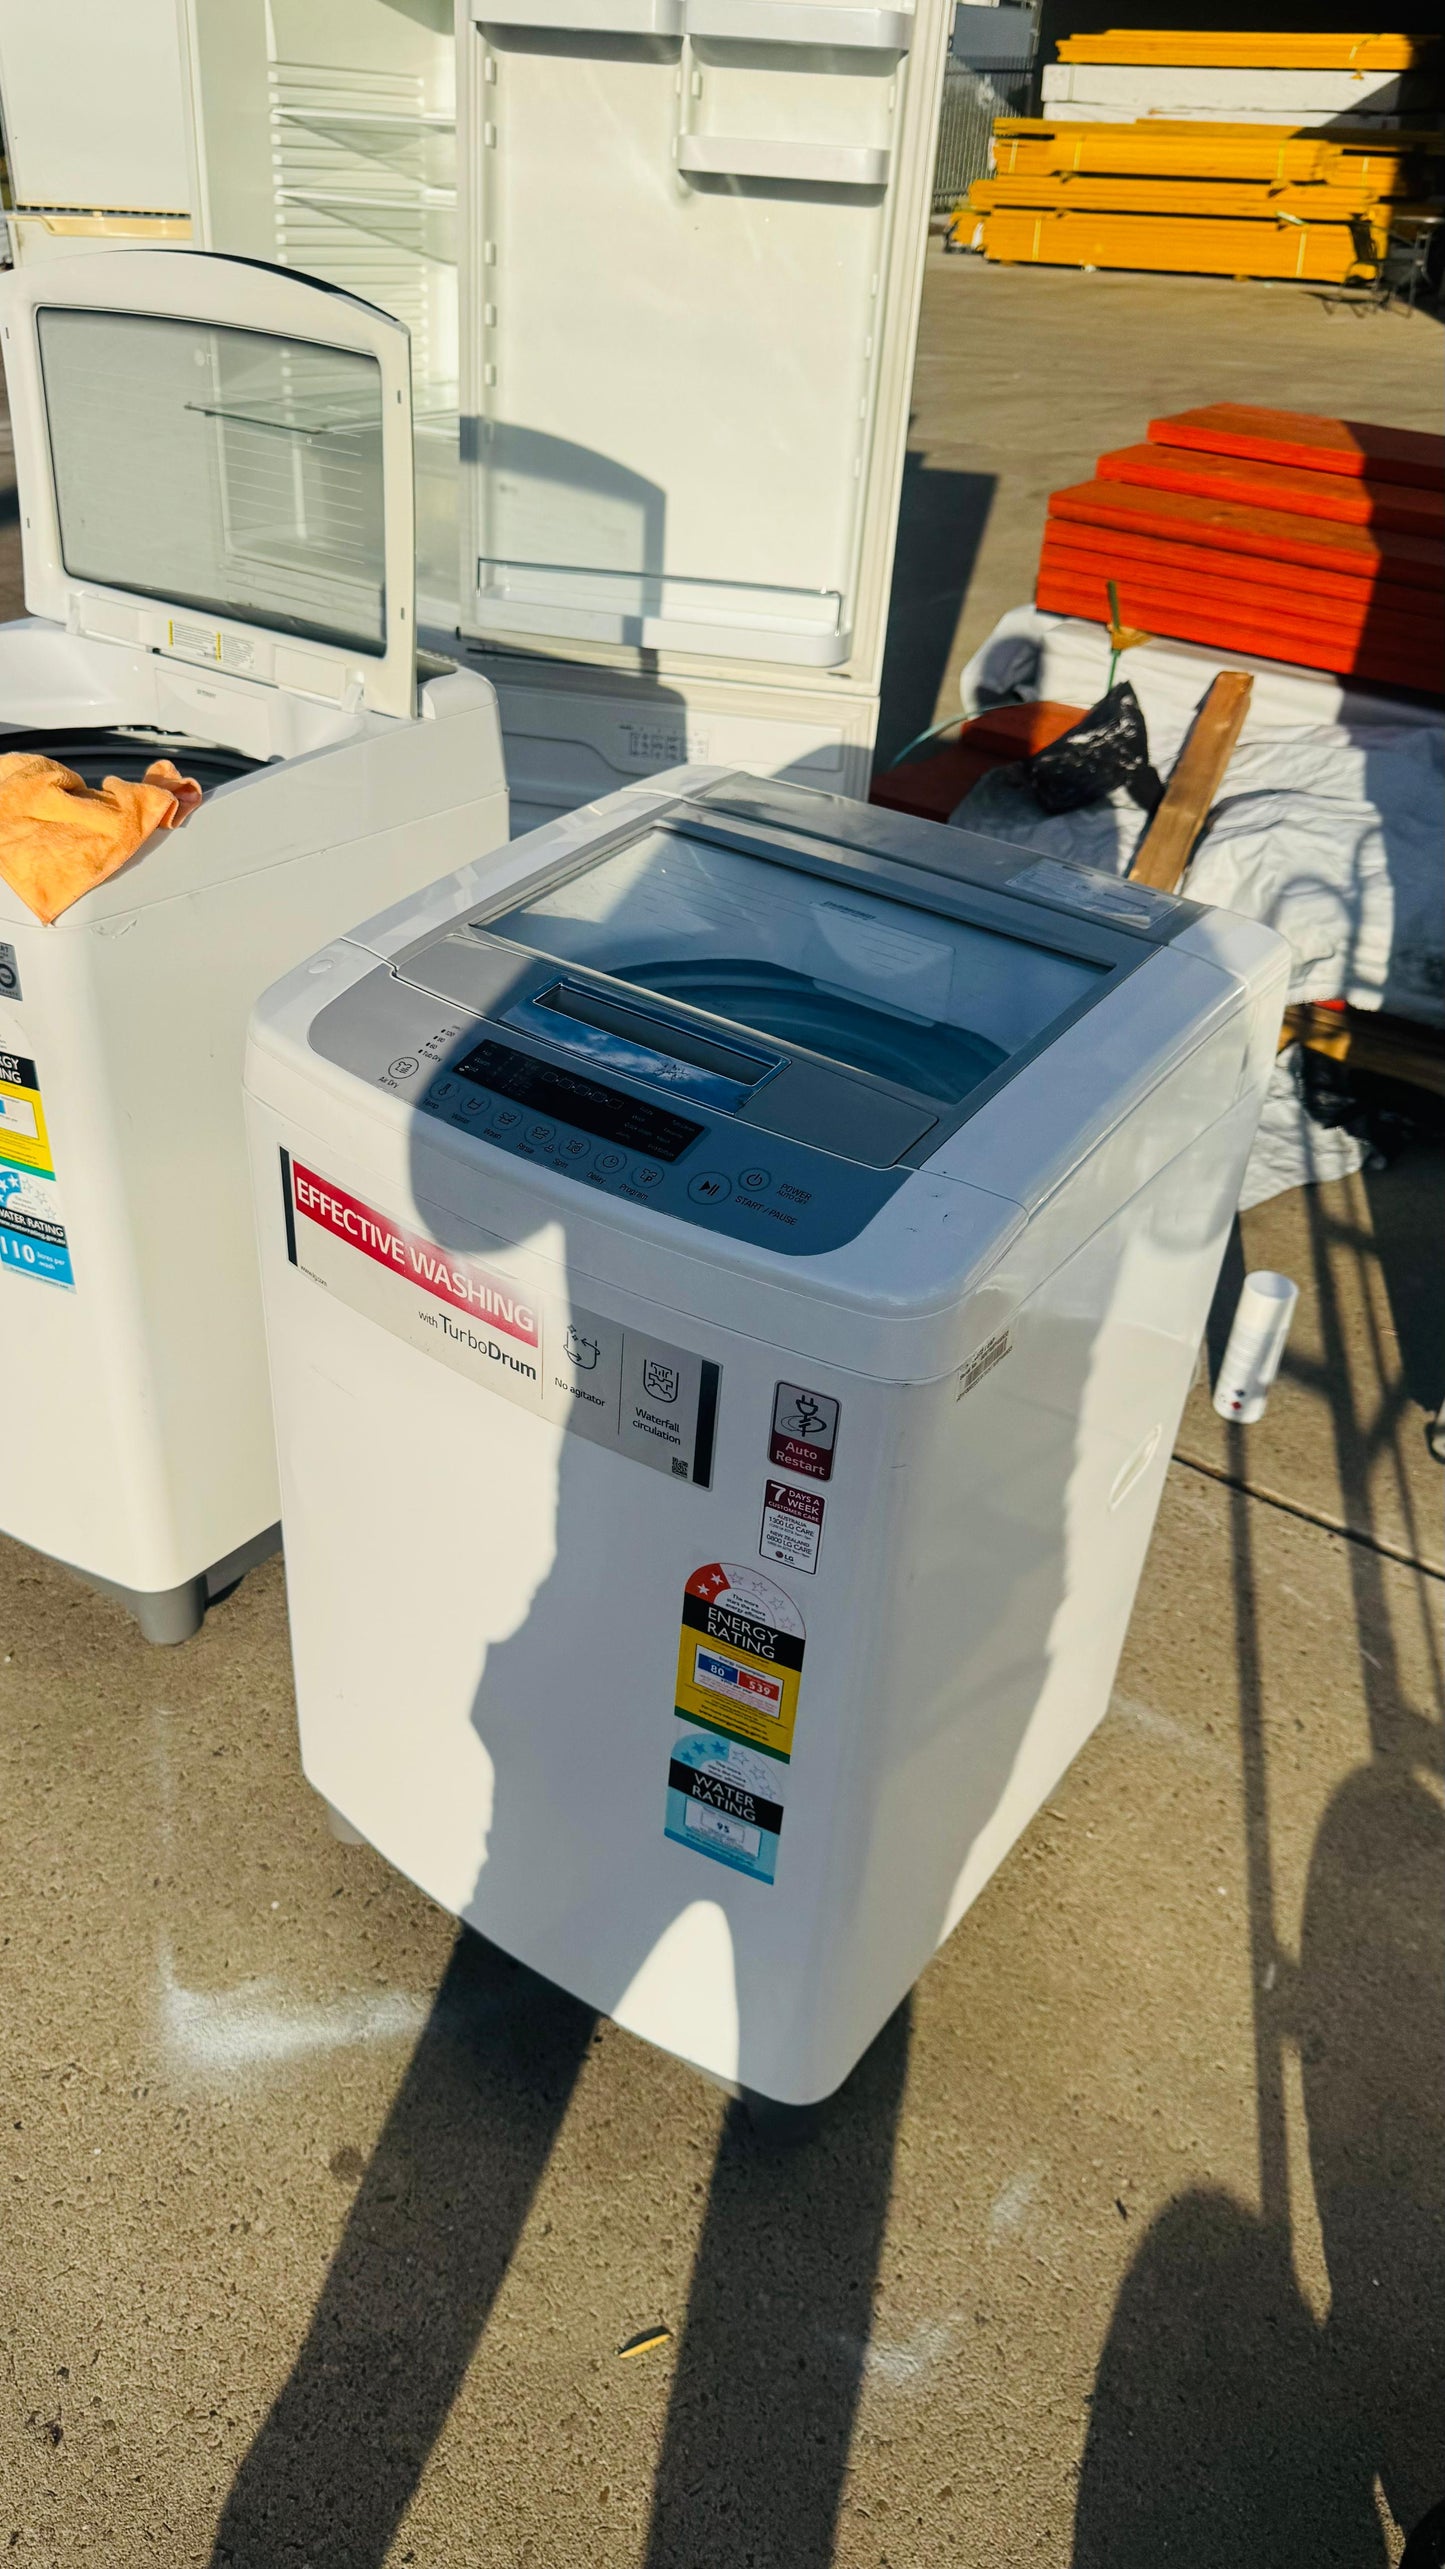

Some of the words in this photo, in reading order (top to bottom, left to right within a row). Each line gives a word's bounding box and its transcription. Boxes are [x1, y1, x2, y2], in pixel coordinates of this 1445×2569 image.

[517, 1142, 535, 1155] Rinse
[553, 1158, 569, 1169] Spin
[587, 1170, 607, 1186] Delay
[620, 1183, 649, 1201] Program
[780, 1182, 812, 1201] POWER
[735, 1194, 763, 1211] START
[768, 1208, 799, 1226] PAUSE
[27, 1216, 64, 1238] RATING
[296, 1176, 406, 1265] EFFECTIVE
[408, 1245, 535, 1333] WASHING
[418, 1311, 439, 1328] with
[438, 1313, 537, 1381] TurboDrum
[554, 1377, 569, 1390] No
[569, 1384, 606, 1407] agitator
[635, 1406, 680, 1433] Waterfall
[632, 1419, 681, 1446] circulation
[785, 1441, 818, 1460] Auto
[775, 1450, 825, 1476] Restart
[770, 1483, 787, 1502] 7
[788, 1490, 811, 1503] DAYS
[768, 1500, 802, 1516] CUSTOMER
[802, 1513, 820, 1522] CARE
[787, 1497, 819, 1515] WEEK
[769, 1516, 784, 1526] 1300
[784, 1522, 795, 1530] LG
[795, 1525, 815, 1538] CARE
[777, 1514, 808, 1528] AUSTRALIA
[783, 1540, 793, 1548] LG
[793, 1543, 813, 1555] CARE
[783, 1554, 794, 1562] LG
[743, 1599, 759, 1608] more
[708, 1606, 779, 1645] ENERGY
[707, 1621, 776, 1660] RATING
[710, 1664, 726, 1677] 80
[748, 1680, 771, 1696] 539
[694, 1772, 755, 1809] WATER
[692, 1784, 756, 1822] RATING
